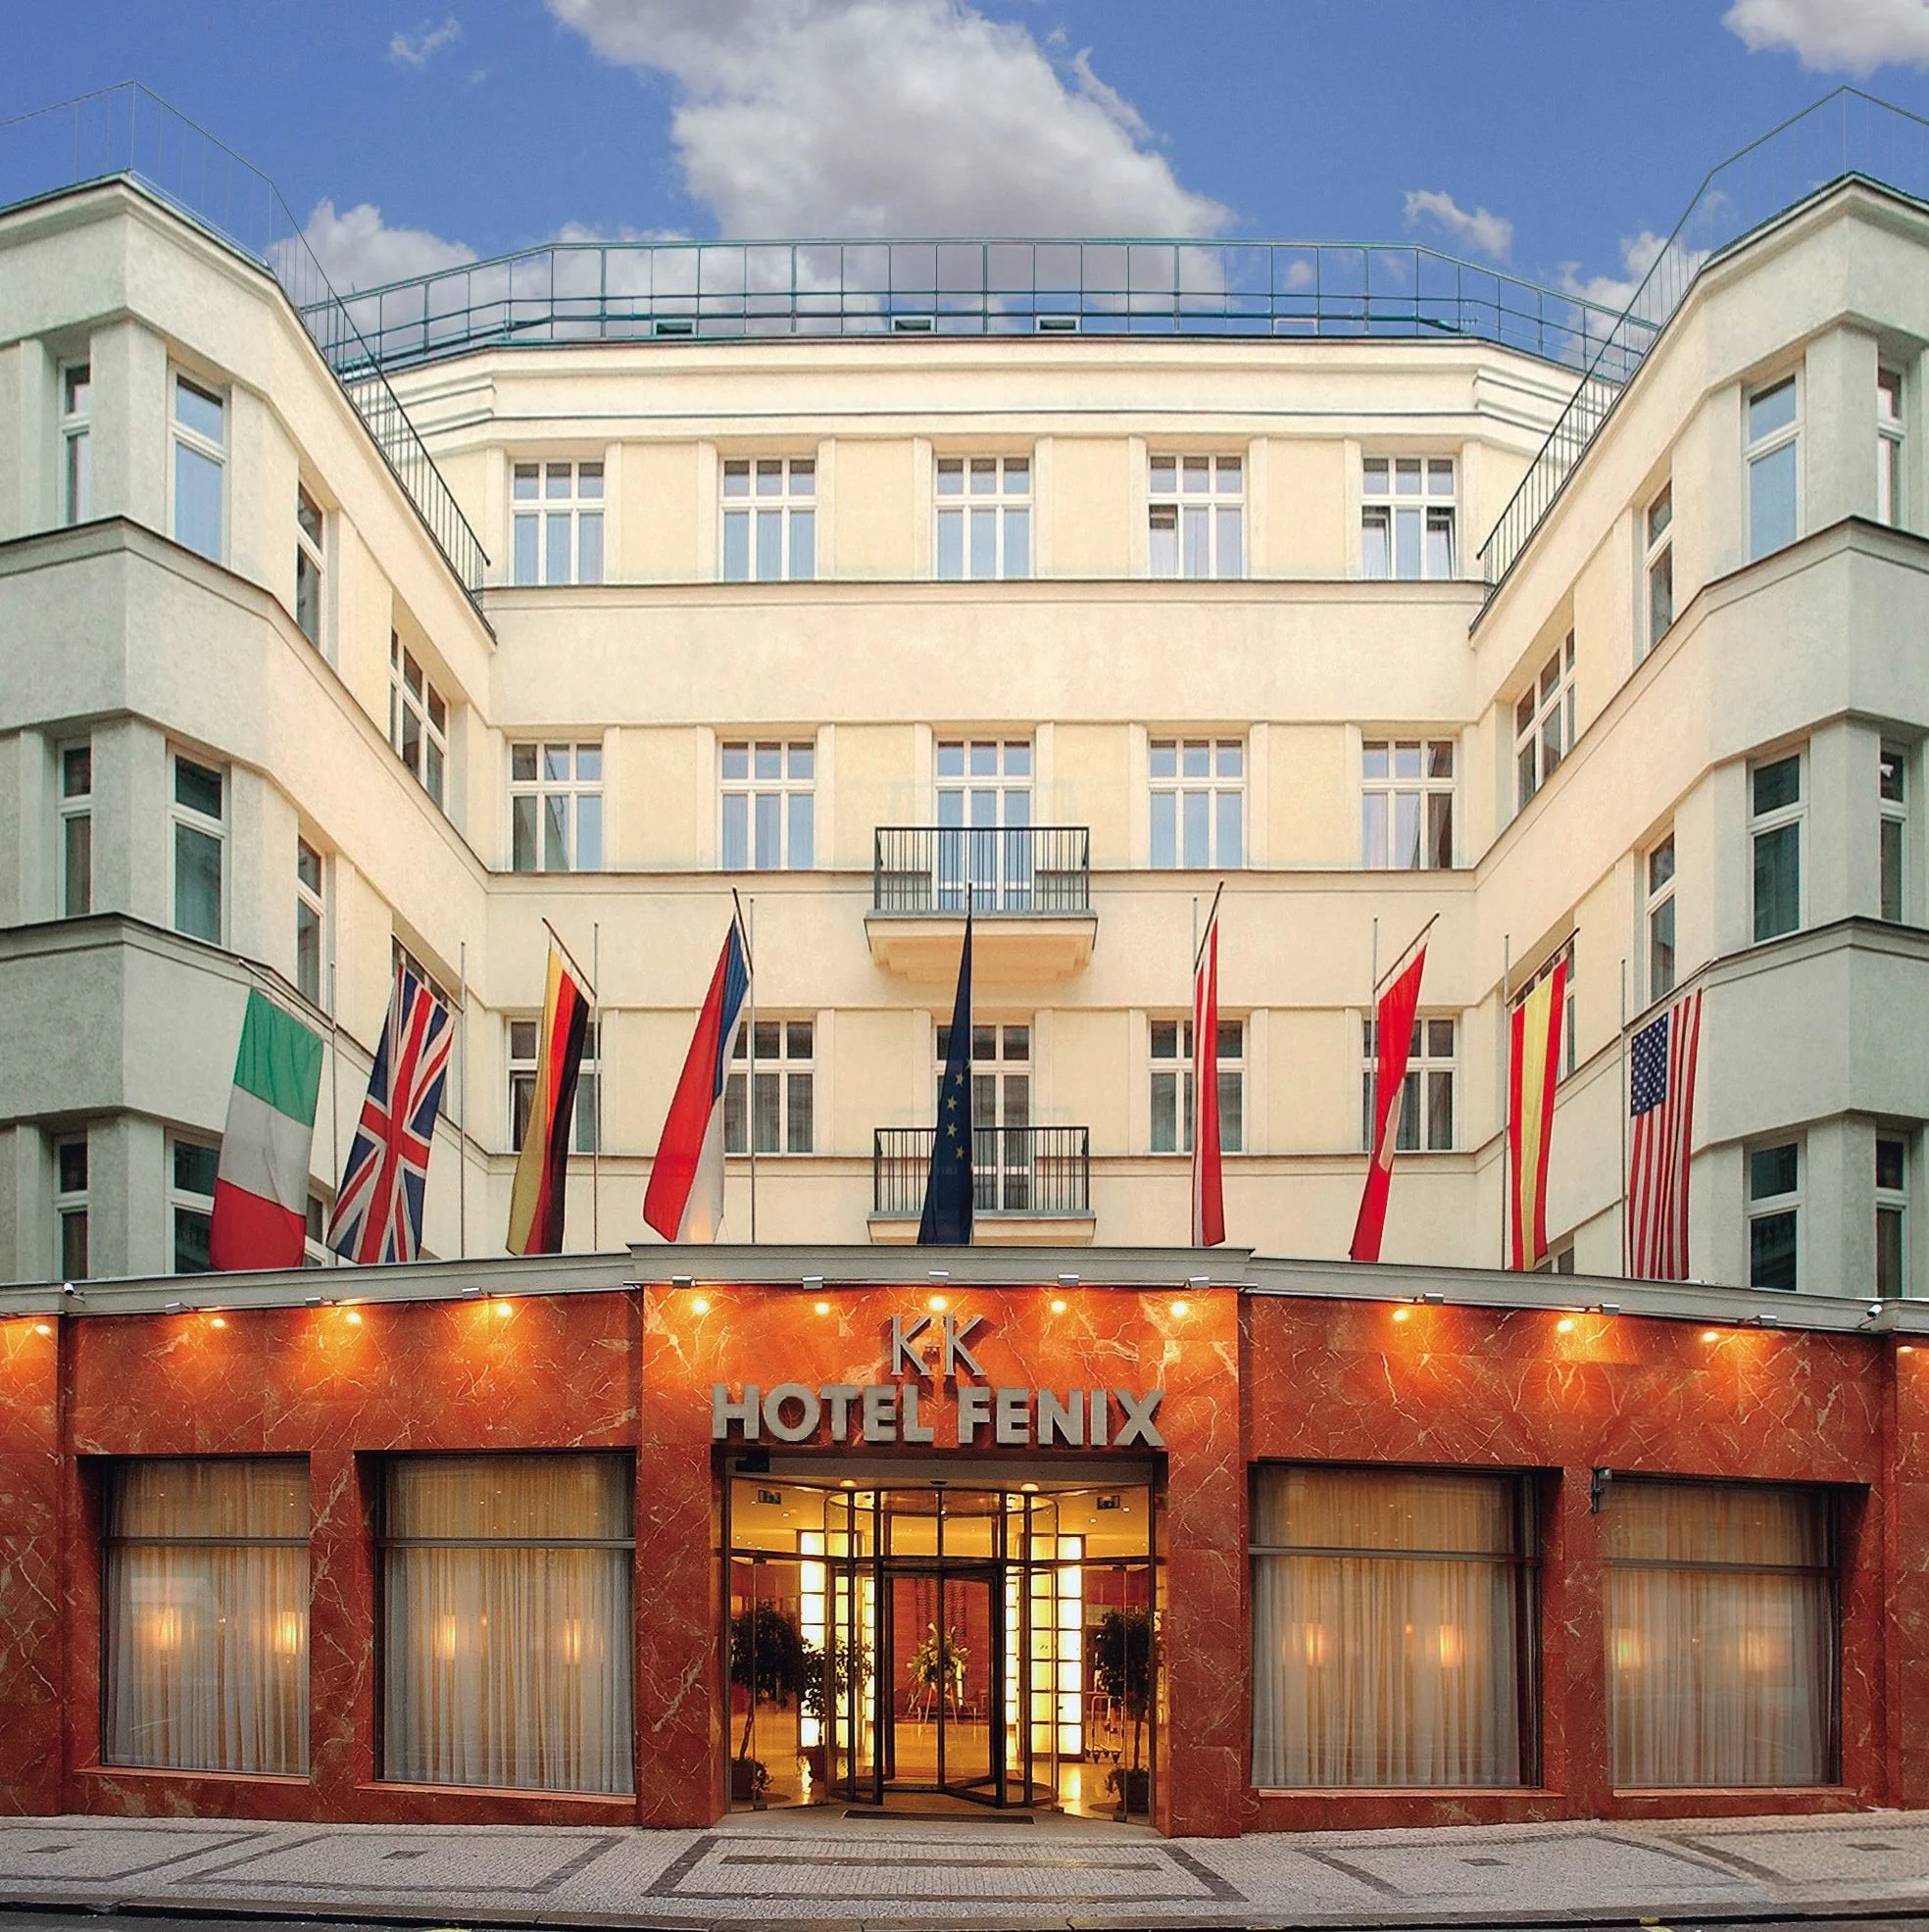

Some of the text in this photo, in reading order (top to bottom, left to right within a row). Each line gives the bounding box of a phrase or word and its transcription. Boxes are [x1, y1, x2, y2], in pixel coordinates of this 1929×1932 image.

[890, 1313, 987, 1376] KK
[713, 1383, 1166, 1447] HOTEL FENIX
